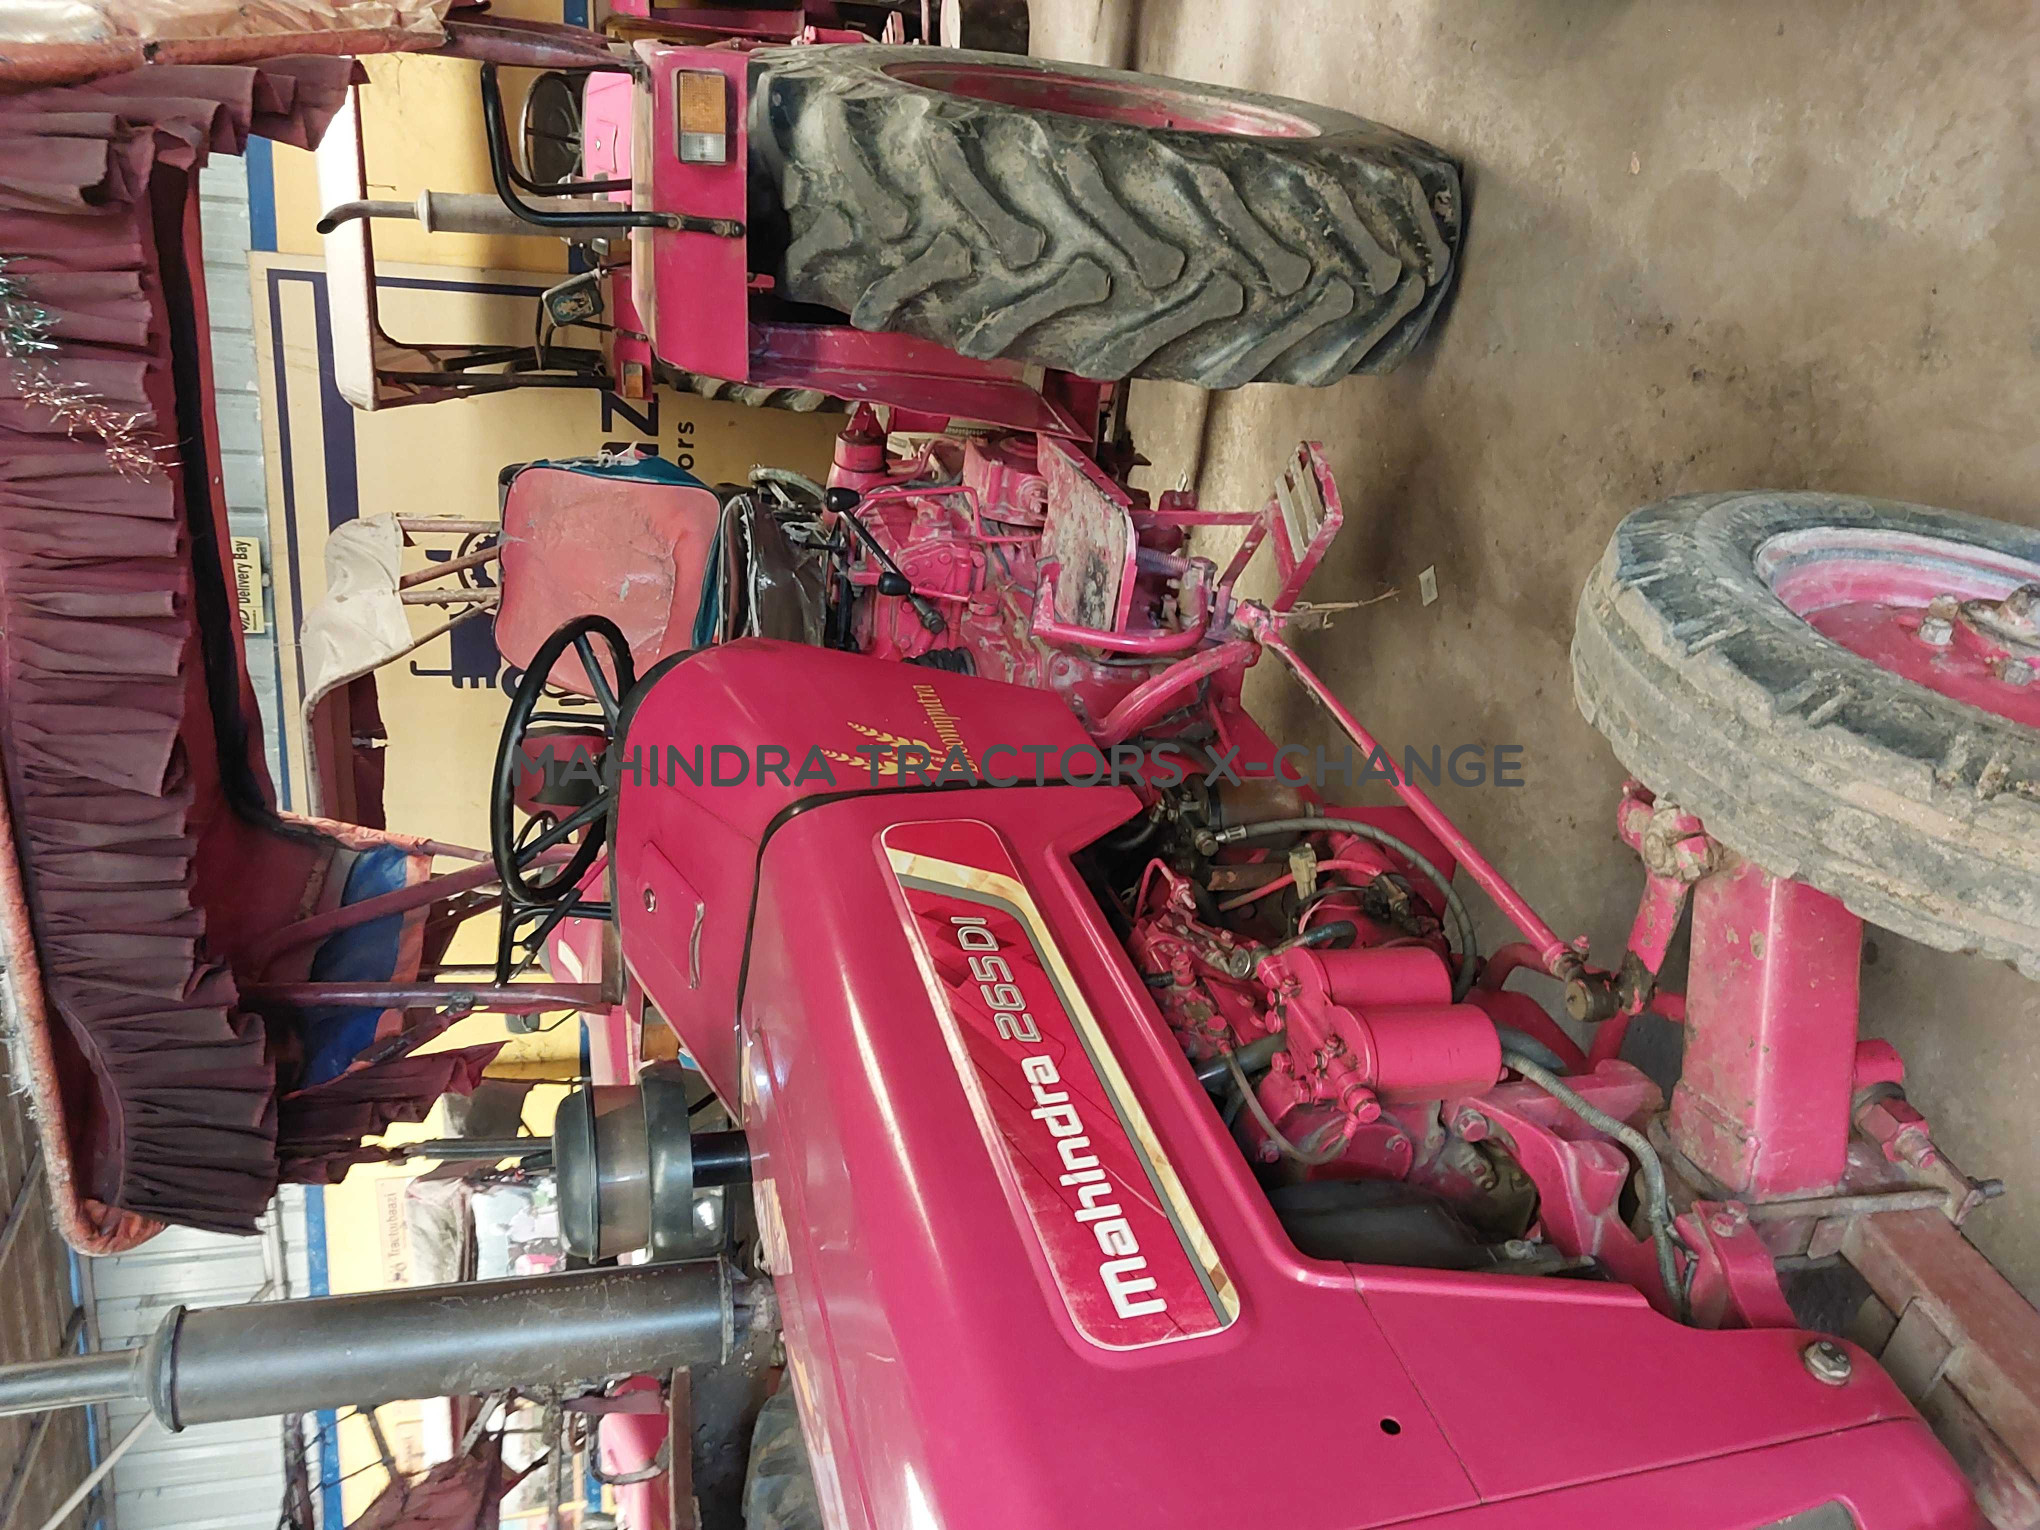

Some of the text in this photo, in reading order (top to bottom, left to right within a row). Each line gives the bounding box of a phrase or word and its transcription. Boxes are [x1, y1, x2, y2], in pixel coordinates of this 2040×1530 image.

[233, 541, 253, 604] Delivery Bay
[950, 915, 1168, 1319] Mahindra 265DI
